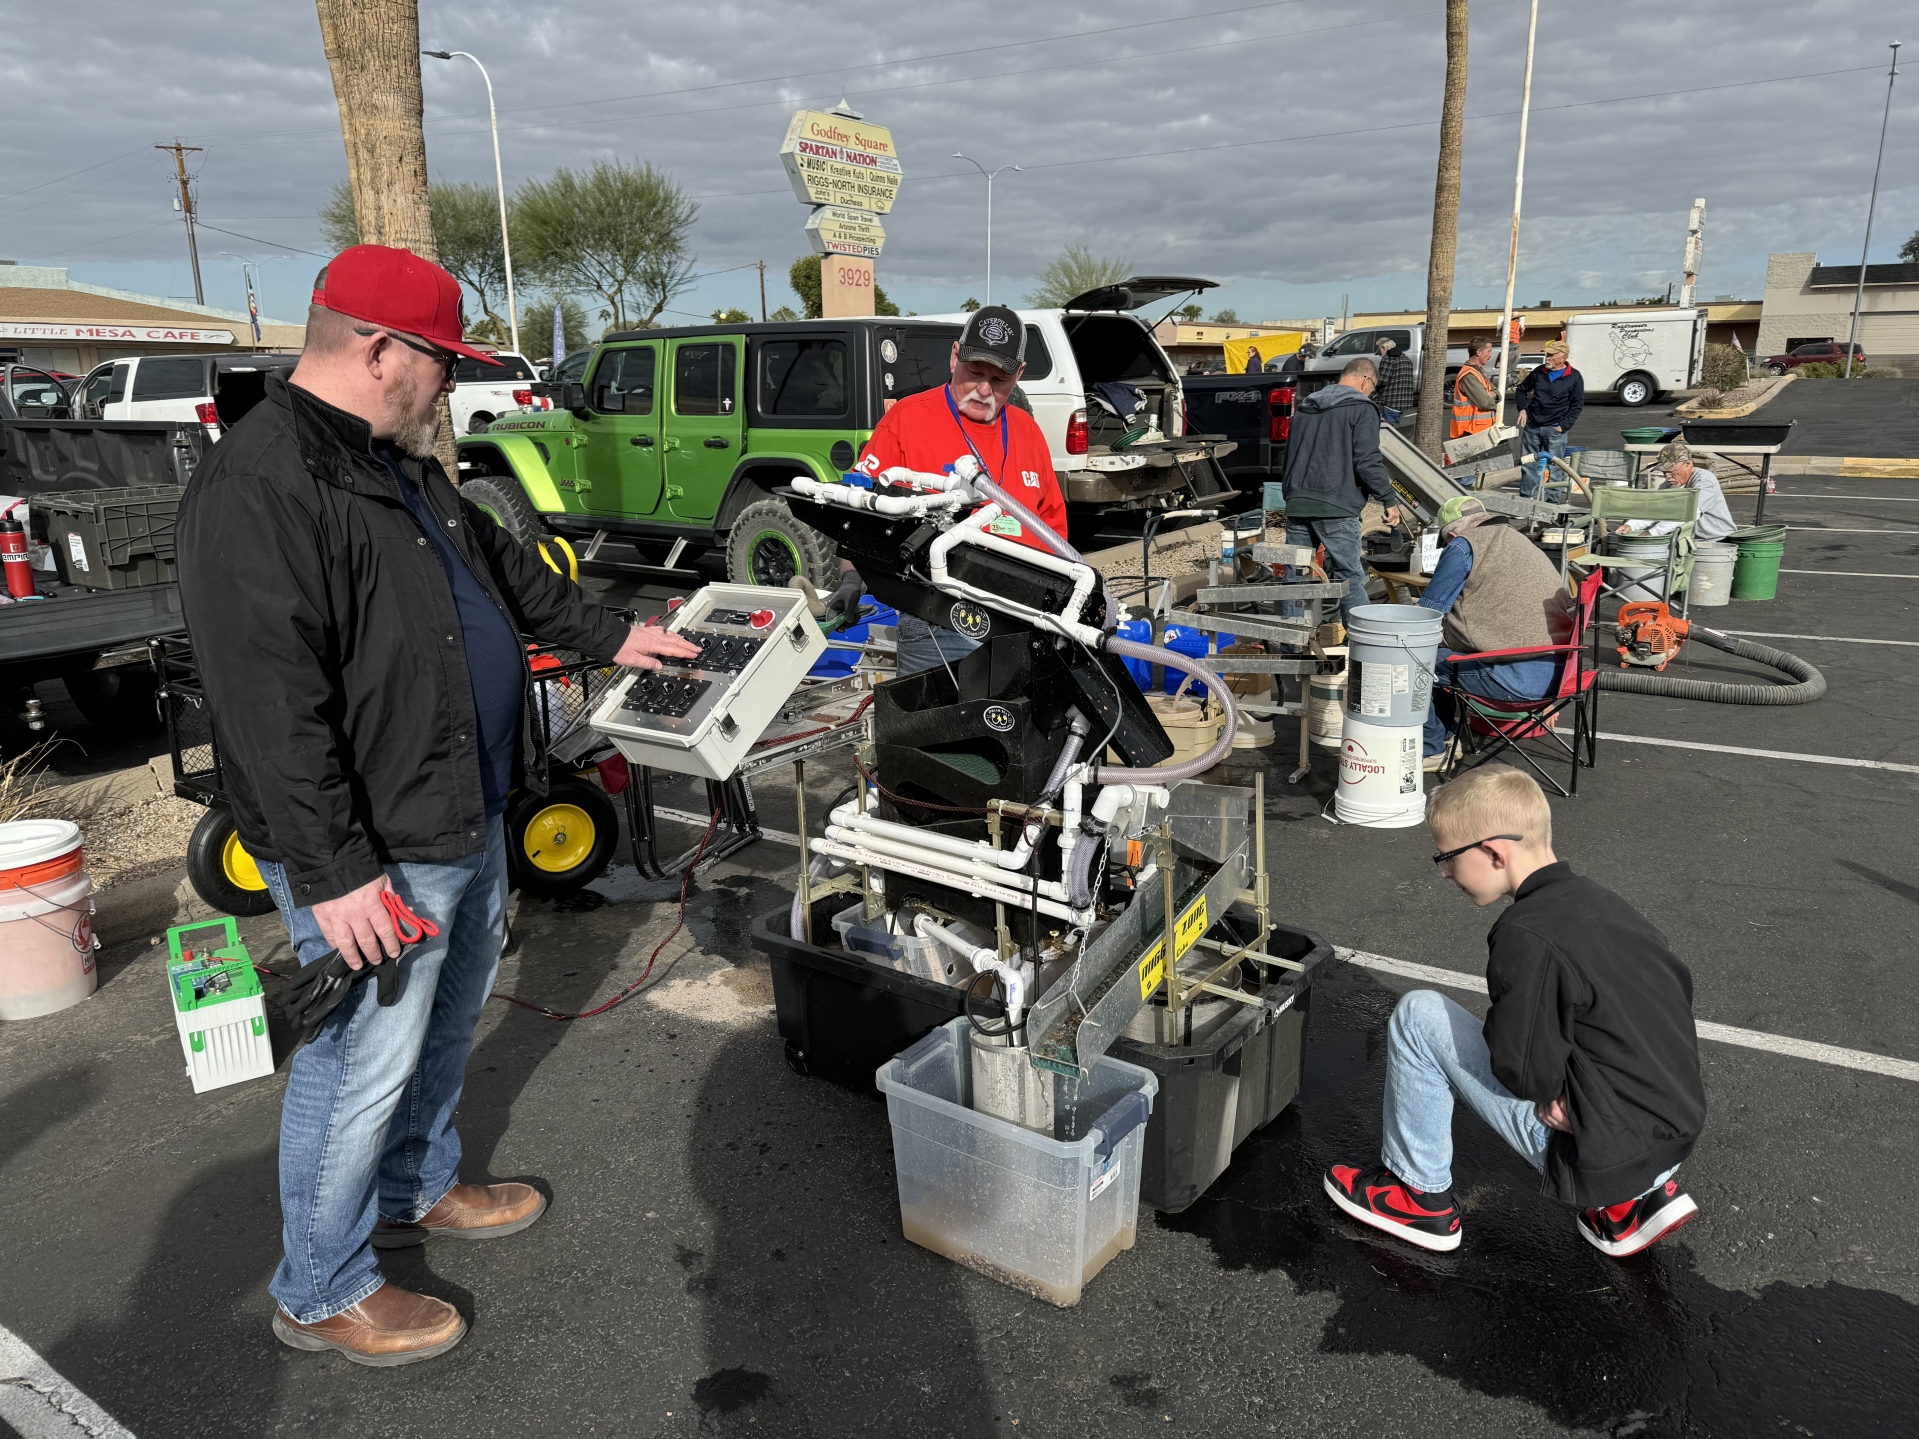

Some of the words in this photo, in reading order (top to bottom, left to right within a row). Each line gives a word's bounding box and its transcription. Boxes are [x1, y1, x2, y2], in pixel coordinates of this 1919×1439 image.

[811, 122, 851, 146] Godfrey
[854, 132, 889, 152] Square
[798, 141, 838, 159] SPARTAN
[845, 150, 878, 167] NATION
[806, 158, 826, 172] MUSIC
[830, 164, 852, 177] Kreative
[853, 169, 865, 180] Kuts
[869, 171, 886, 184] Quinns
[887, 174, 898, 186] Nails
[807, 174, 856, 193] RIGGS-NORTH
[857, 183, 894, 200] INSURANCE
[814, 188, 830, 198] John's
[840, 196, 863, 207] Duchess
[831, 211, 846, 219] World
[846, 213, 859, 221] Span
[860, 215, 874, 223] Travel
[839, 222, 857, 232] Arizona
[858, 225, 871, 233] Thrift
[848, 233, 876, 245] Prospecting
[838, 267, 871, 287] 3929
[978, 317, 1014, 336] CATERPILLAR
[13, 327, 68, 336] LITTLE
[75, 328, 137, 339] MESA
[145, 330, 201, 341] CAFE
[1215, 390, 1260, 403] FX4
[492, 421, 546, 431] RUBICON
[1021, 470, 1040, 488] CAT
[1392, 479, 1414, 501] KEENE
[3, 553, 30, 561] EMPIR
[1349, 761, 1385, 775] LOCALLY
[1181, 900, 1205, 936] ZONE
